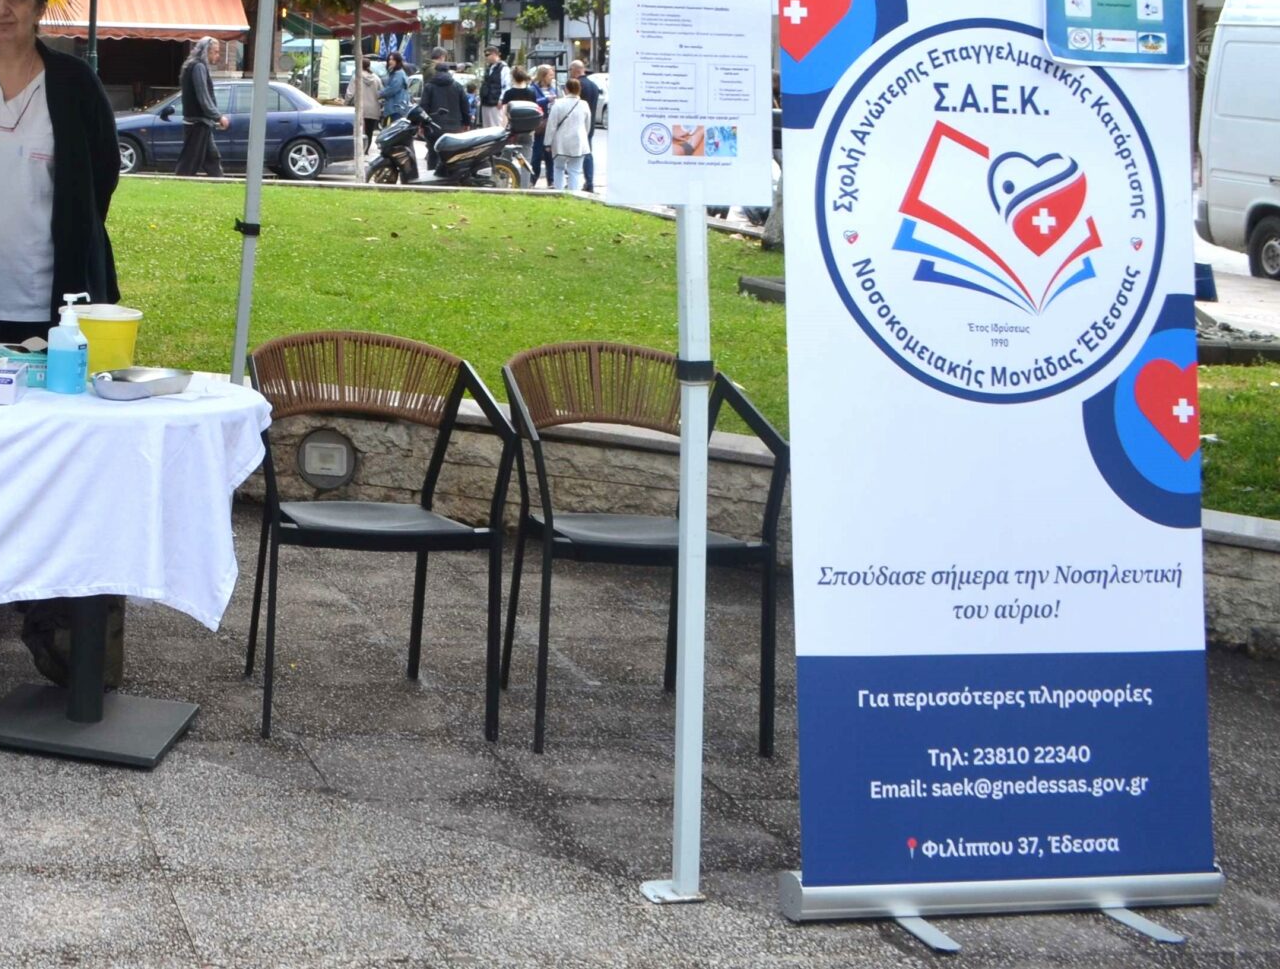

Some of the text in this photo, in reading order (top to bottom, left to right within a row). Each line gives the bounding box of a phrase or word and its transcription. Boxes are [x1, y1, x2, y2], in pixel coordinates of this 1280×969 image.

[933, 82, 1050, 116] Σ.Α.Ε.Κ.
[832, 41, 1146, 220] Σχολή Ανώτερης Επαγγελματικής Κατάρτισης
[852, 257, 1141, 389] Νοσοκομειακής Μονάδας Έδεσσας
[967, 322, 990, 334] Έτος
[990, 338, 1010, 348] 1990
[817, 562, 1183, 591] Σπούδασε σήμερα την Νοσηλευτική
[952, 598, 1061, 625] του αύριο!
[857, 683, 1153, 712] Για περισσότερες πληροφορίες
[927, 745, 1091, 772] Τηλ: 23810 22340
[870, 775, 1149, 800] Email: saek@gnedessas.gov.gr
[921, 834, 1121, 858] Φιλίππου 37, Έδεσσα
